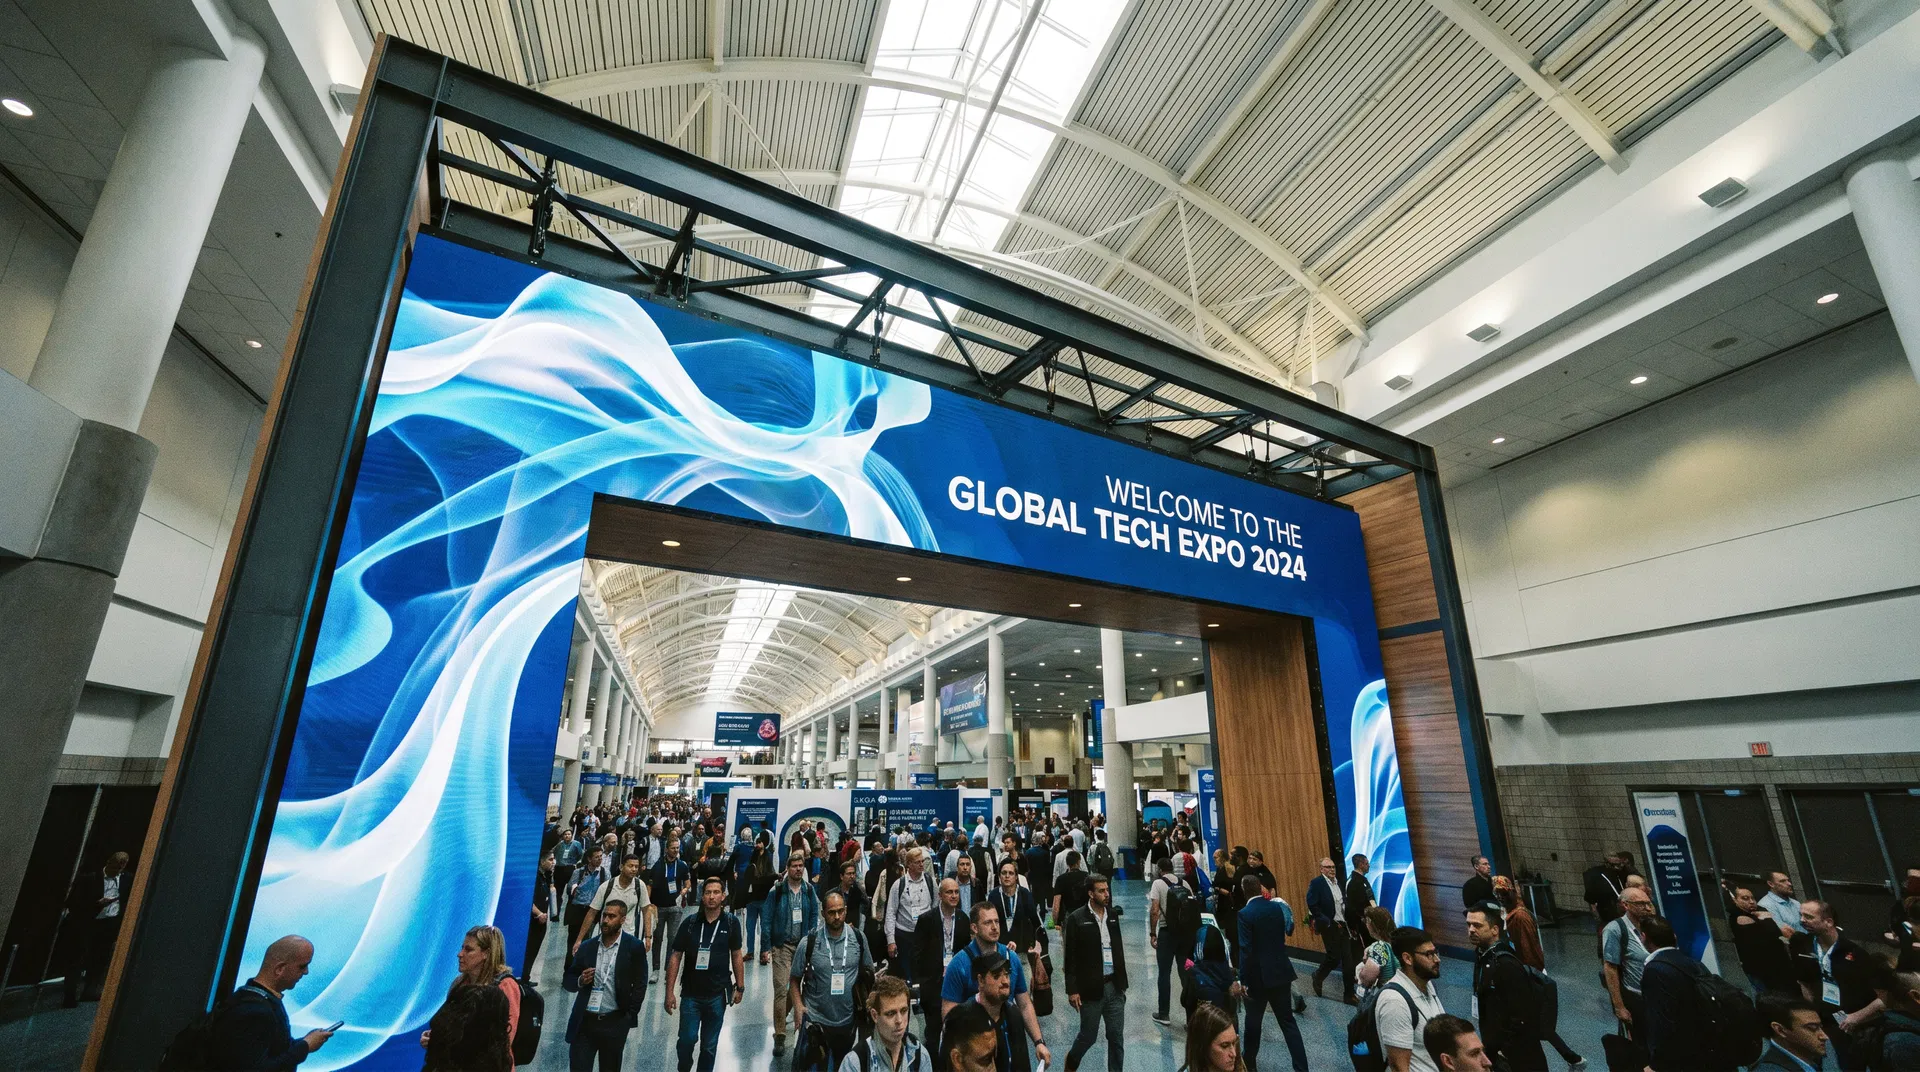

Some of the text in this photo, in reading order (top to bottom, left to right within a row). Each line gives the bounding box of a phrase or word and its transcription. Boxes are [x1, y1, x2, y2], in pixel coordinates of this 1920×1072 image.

[948, 475, 1308, 582] GLOBAL TECH EXPO 2024
[1105, 475, 1304, 549] WELCOME TO THE
